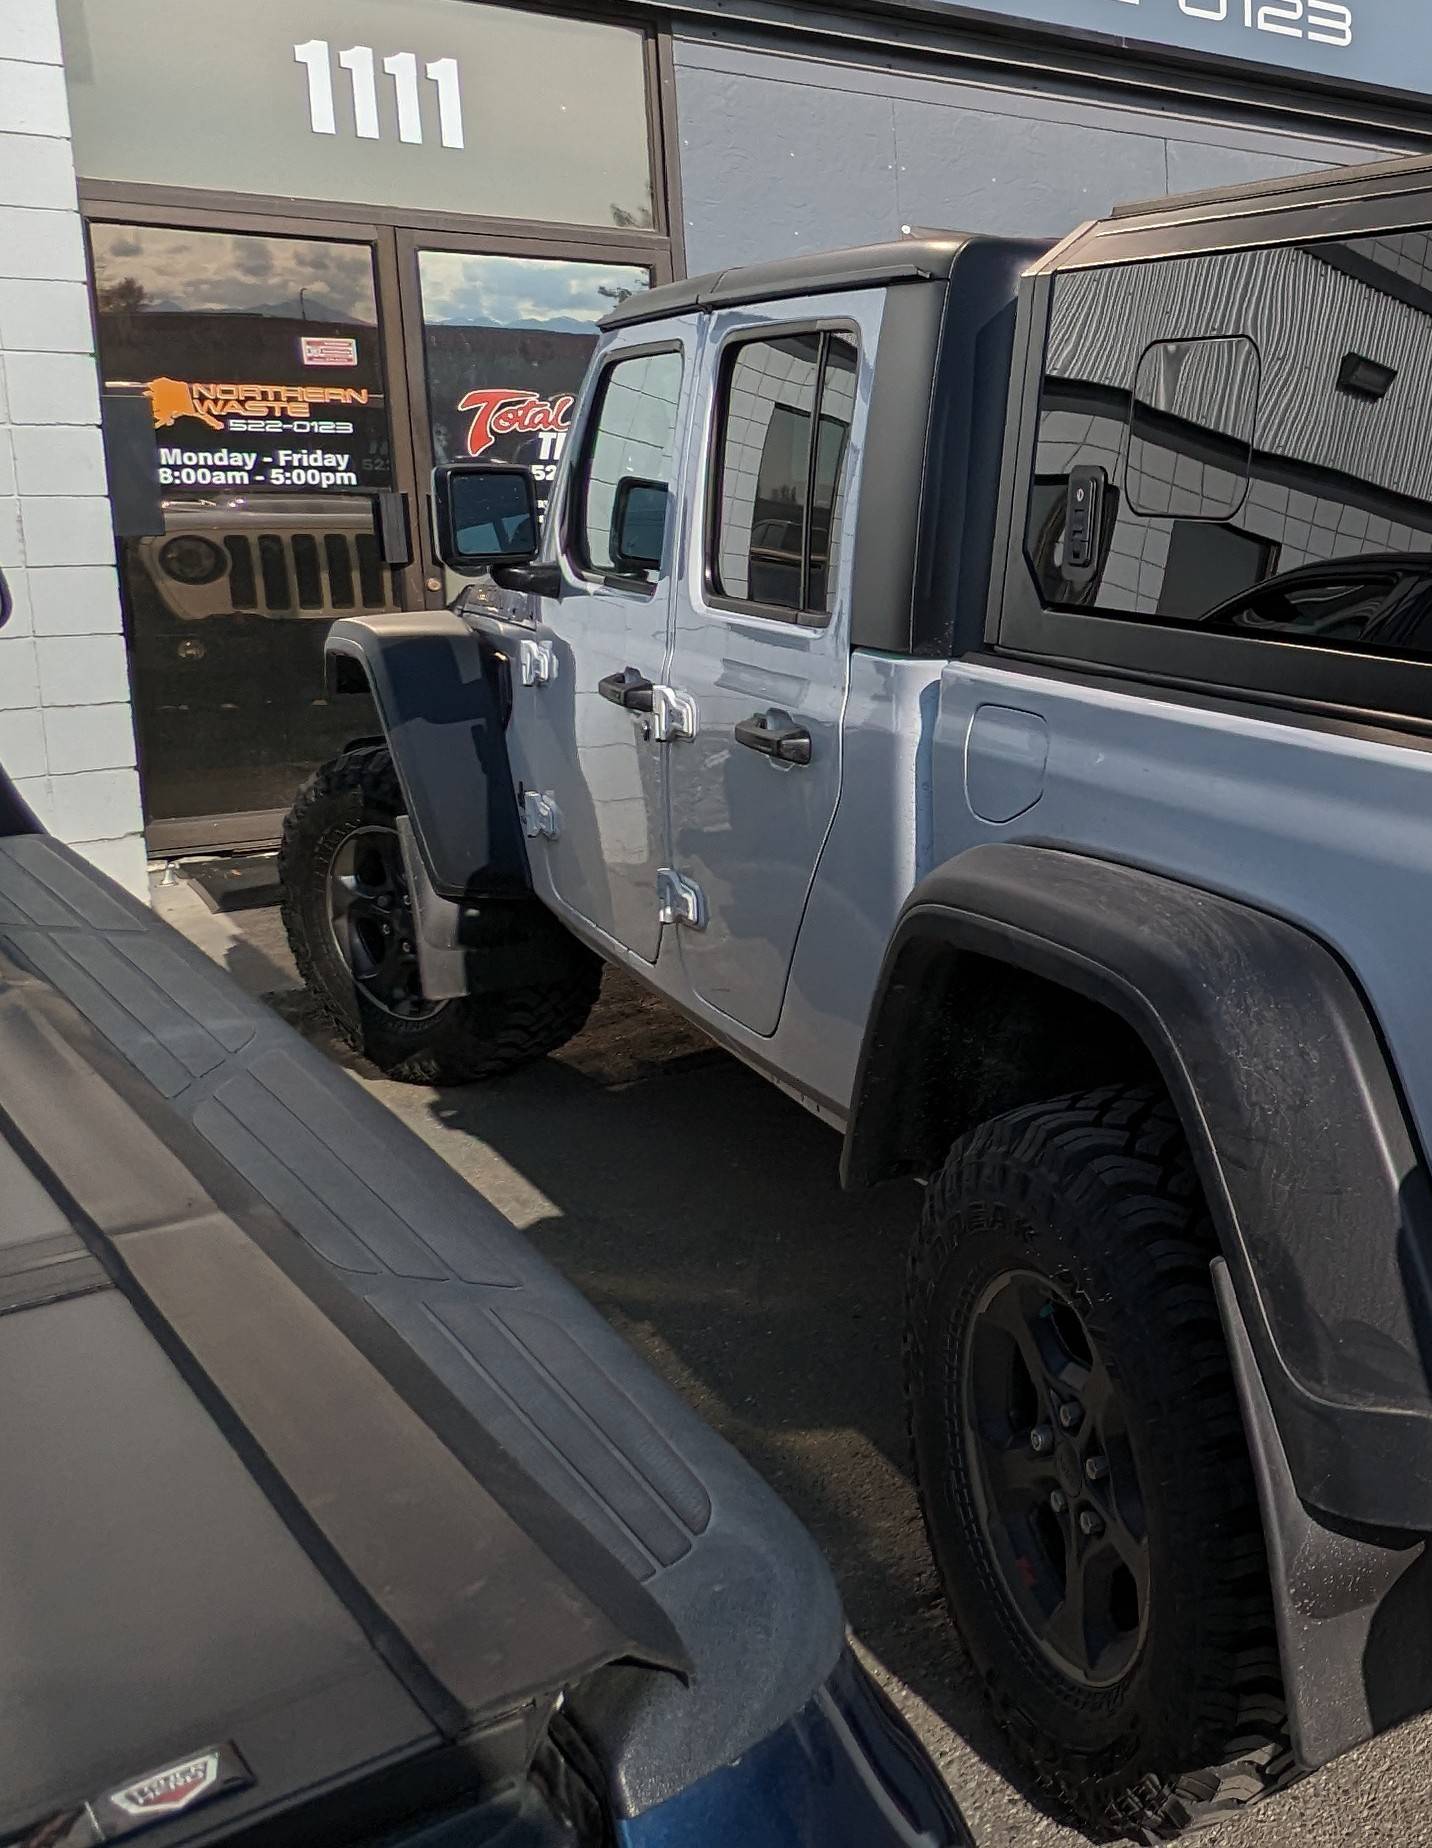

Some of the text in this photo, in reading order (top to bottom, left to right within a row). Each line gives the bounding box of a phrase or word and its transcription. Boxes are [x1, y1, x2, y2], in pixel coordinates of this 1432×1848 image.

[293, 39, 465, 149] 1111
[192, 384, 369, 405] NORTHERN
[193, 399, 310, 418] WASTE
[228, 419, 354, 434] 522-0123
[458, 388, 575, 457] Total
[159, 447, 257, 471] Monday
[277, 449, 351, 471] Friday
[157, 467, 250, 485] 8:00am
[270, 468, 358, 488] 5:00pm
